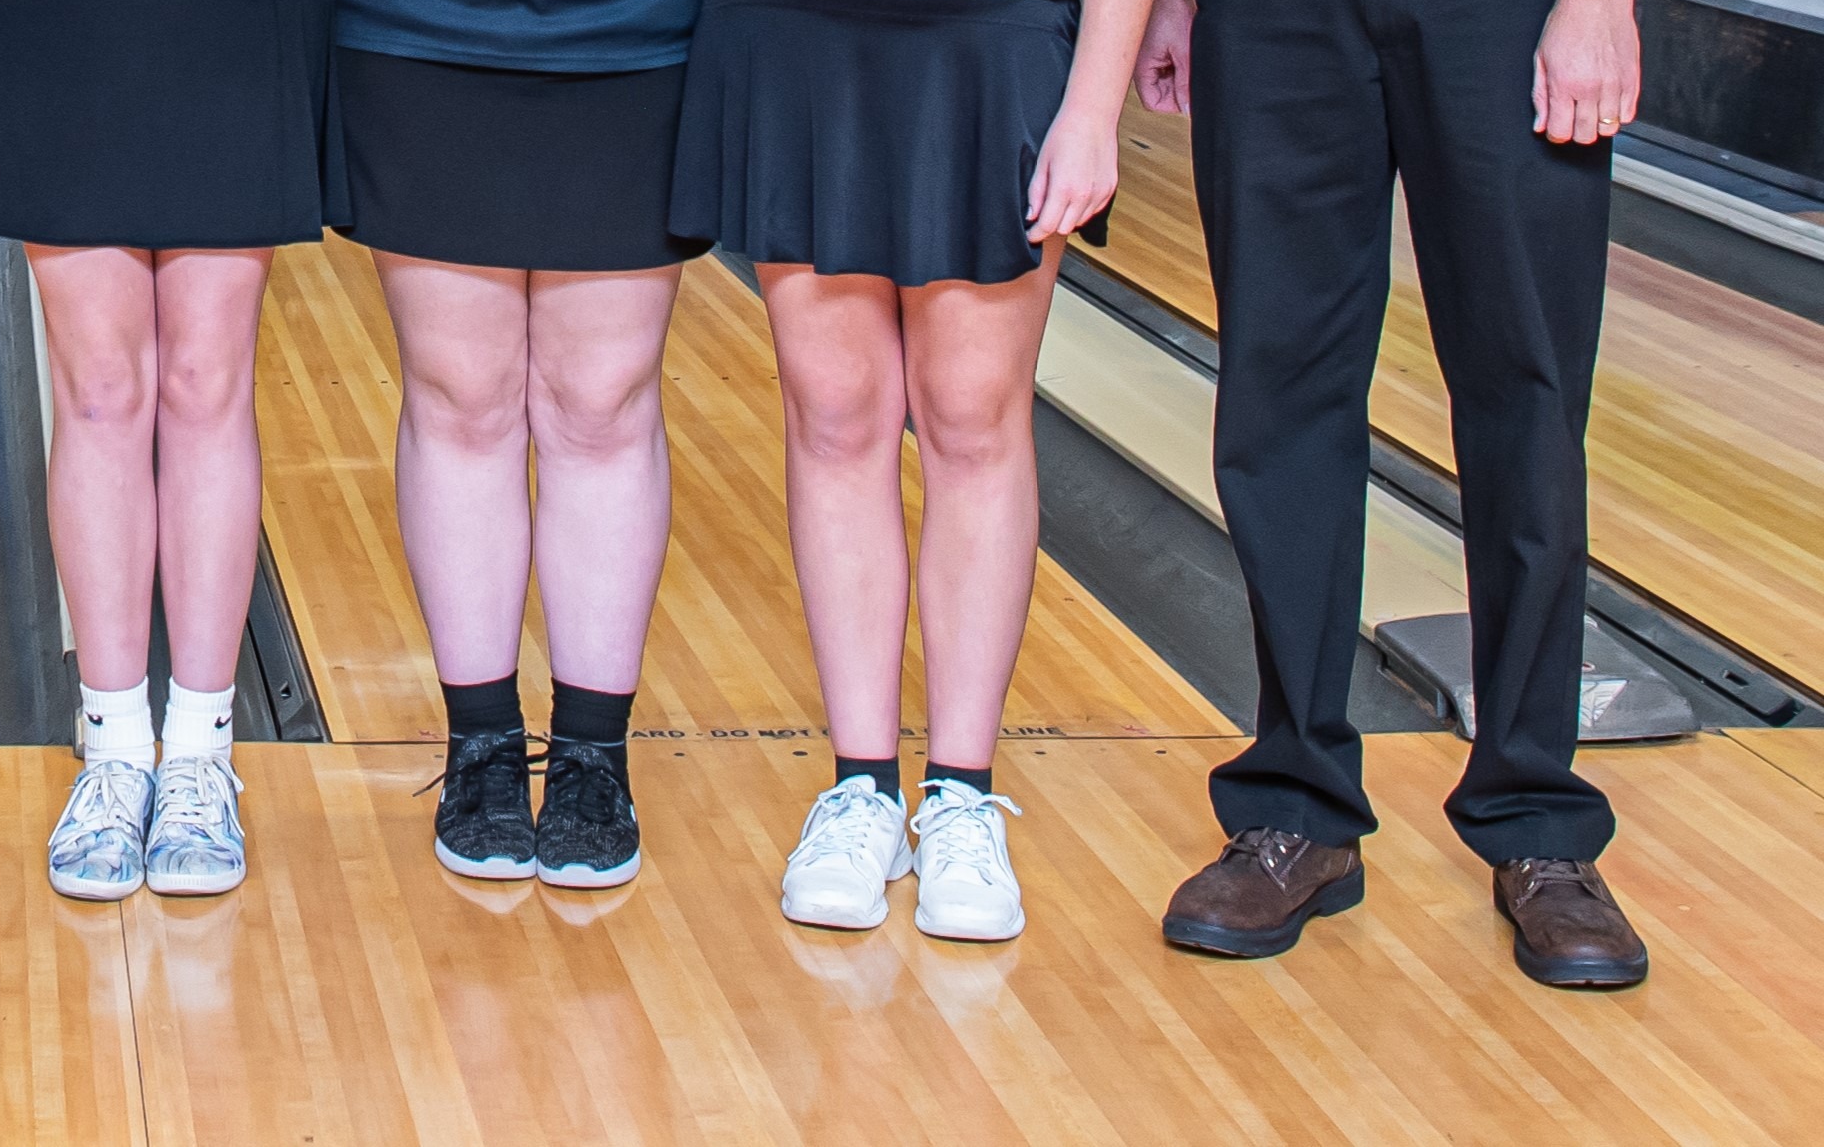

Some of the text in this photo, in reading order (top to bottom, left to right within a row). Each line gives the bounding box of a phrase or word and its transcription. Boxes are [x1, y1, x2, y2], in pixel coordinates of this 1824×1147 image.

[631, 730, 686, 739] ARD
[710, 729, 750, 738] DO
[758, 729, 811, 739] NOT
[1001, 727, 1066, 736] LINE
